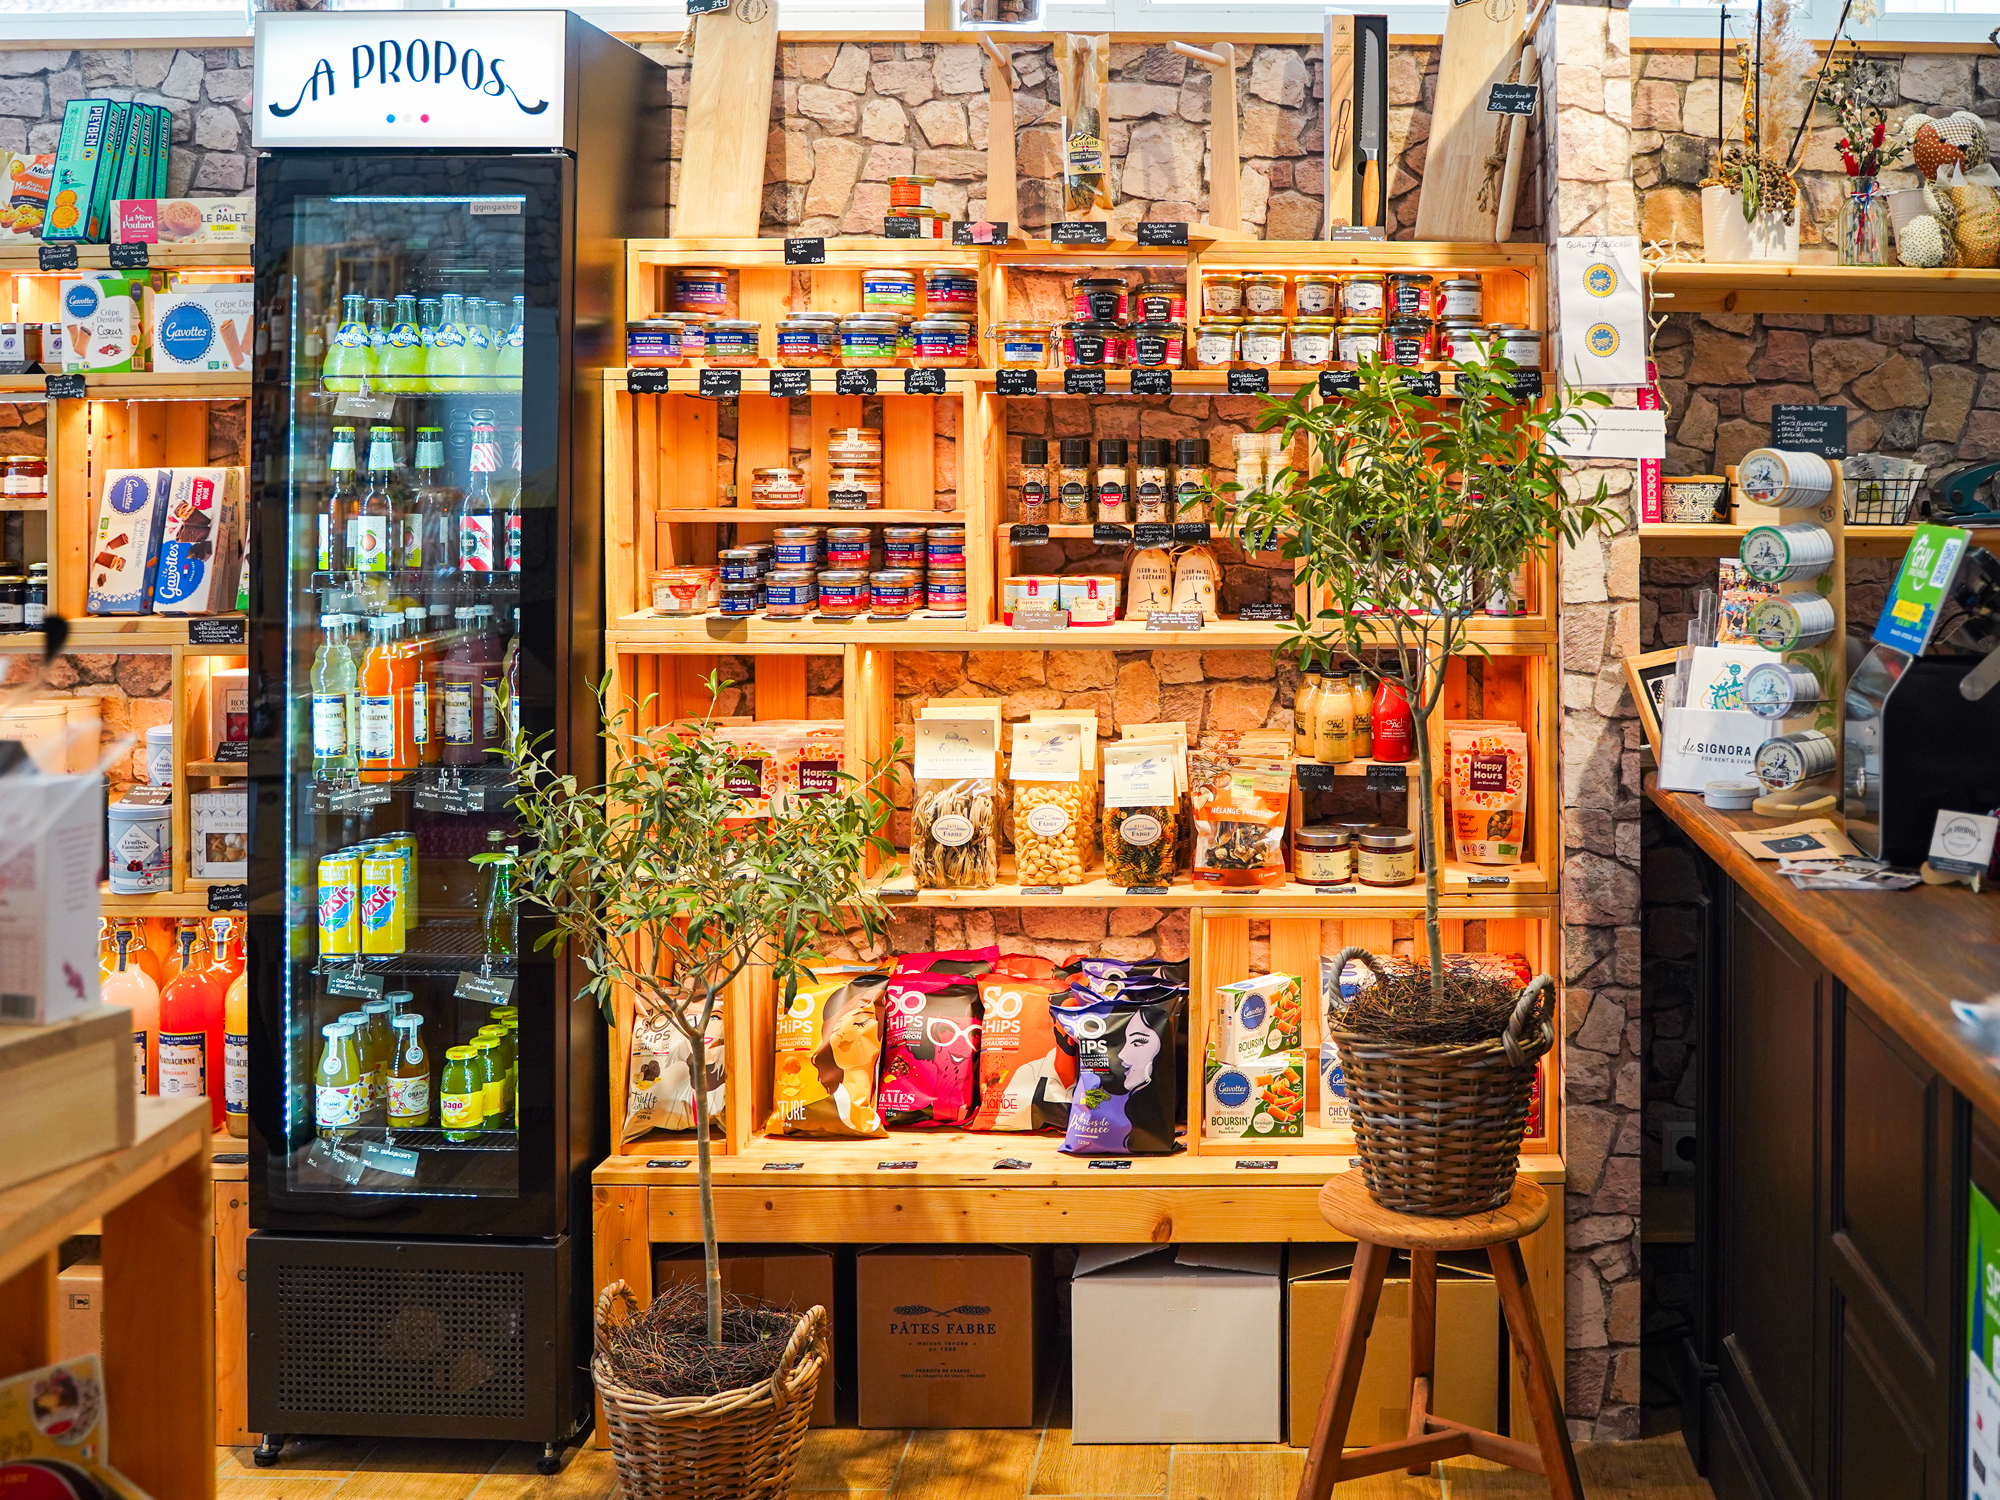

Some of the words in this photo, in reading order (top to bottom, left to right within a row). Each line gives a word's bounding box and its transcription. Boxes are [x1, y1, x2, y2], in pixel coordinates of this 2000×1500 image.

[353, 39, 507, 97] PROPOS
[85, 106, 104, 147] PLEYBEN
[108, 110, 119, 143] PLEYBEN
[130, 113, 141, 146] PLEYBEN
[143, 113, 152, 146] PLEYBEN
[161, 117, 169, 149] PLEYBEN
[473, 204, 518, 214] ggmgastro
[125, 214, 135, 222] La
[135, 212, 153, 222] Mère
[201, 214, 213, 223] LE
[216, 213, 247, 223] PALET
[122, 220, 155, 230] Poulard
[69, 295, 95, 306] Gavottes
[100, 308, 120, 318] Crêpe
[96, 315, 124, 324] Dentelle
[97, 327, 123, 337] Cœur
[166, 322, 209, 341] Gavottes
[4, 339, 15, 348] 91
[124, 479, 139, 510] Gavottes
[194, 480, 203, 507] CHOCOLAT
[1646, 468, 1657, 512] SORCIER
[1911, 546, 1935, 570] GHV
[159, 542, 183, 600] Gavottes
[1682, 738, 1697, 757] die
[1697, 743, 1751, 757] SIGNORA
[1473, 761, 1503, 772] Happy
[1473, 771, 1503, 780] Hours
[803, 778, 833, 787] Hours
[1211, 806, 1240, 815] MÉLANGE
[1242, 809, 1273, 818] FORESTIER
[886, 985, 927, 1018] SO
[983, 986, 1023, 1020] SO
[1243, 1008, 1265, 1019] Gavottes
[1058, 1012, 1107, 1040] SO
[171, 1034, 202, 1042] LIMONADES
[1238, 1036, 1265, 1052] BOURSIN
[1218, 1083, 1247, 1096] Gavottes
[878, 1093, 915, 1104] BAIES
[1328, 1106, 1351, 1116] CHÈV
[1100, 1117, 1109, 1126] de
[1211, 1116, 1249, 1126] BOURSIN
[889, 1321, 940, 1335] PÂTES
[946, 1323, 996, 1335] FABRE
